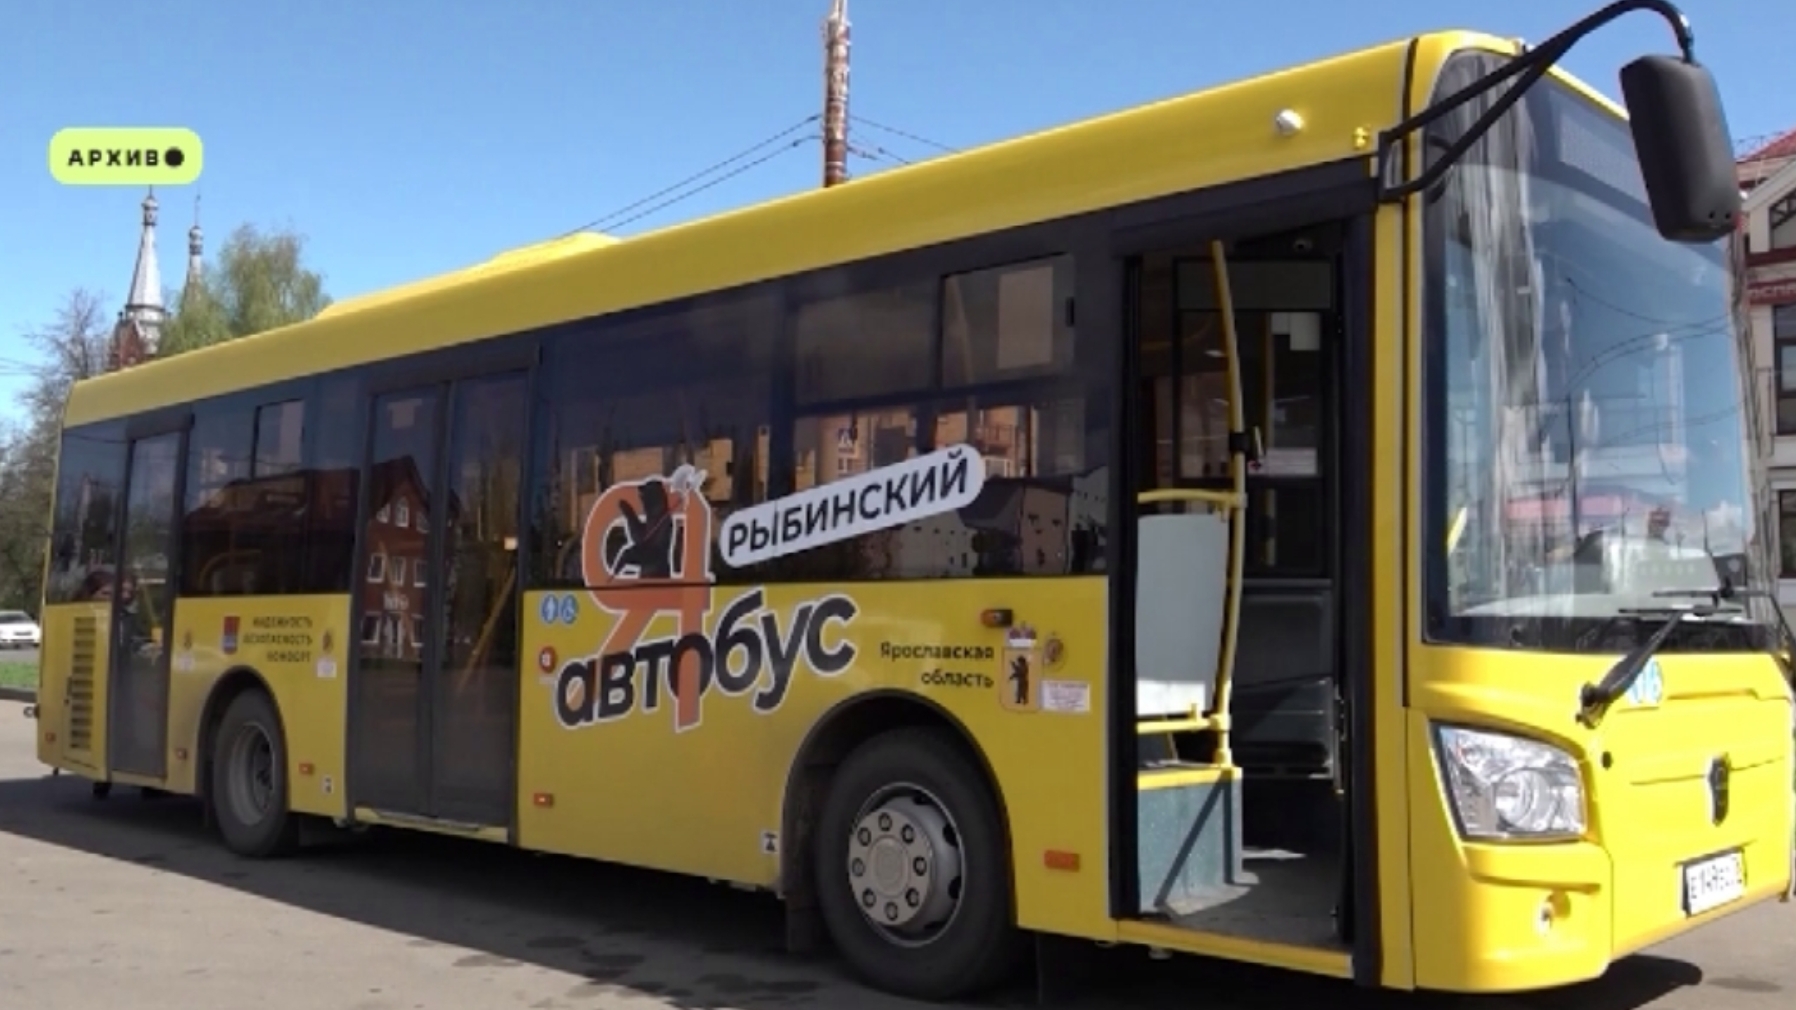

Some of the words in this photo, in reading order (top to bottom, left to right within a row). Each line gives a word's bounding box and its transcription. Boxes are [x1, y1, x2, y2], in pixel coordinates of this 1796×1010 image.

[728, 449, 969, 558] РЫБИНСКИЙ
[557, 588, 856, 727] автобус
[880, 642, 995, 661] Ярославская
[921, 669, 995, 689] область
